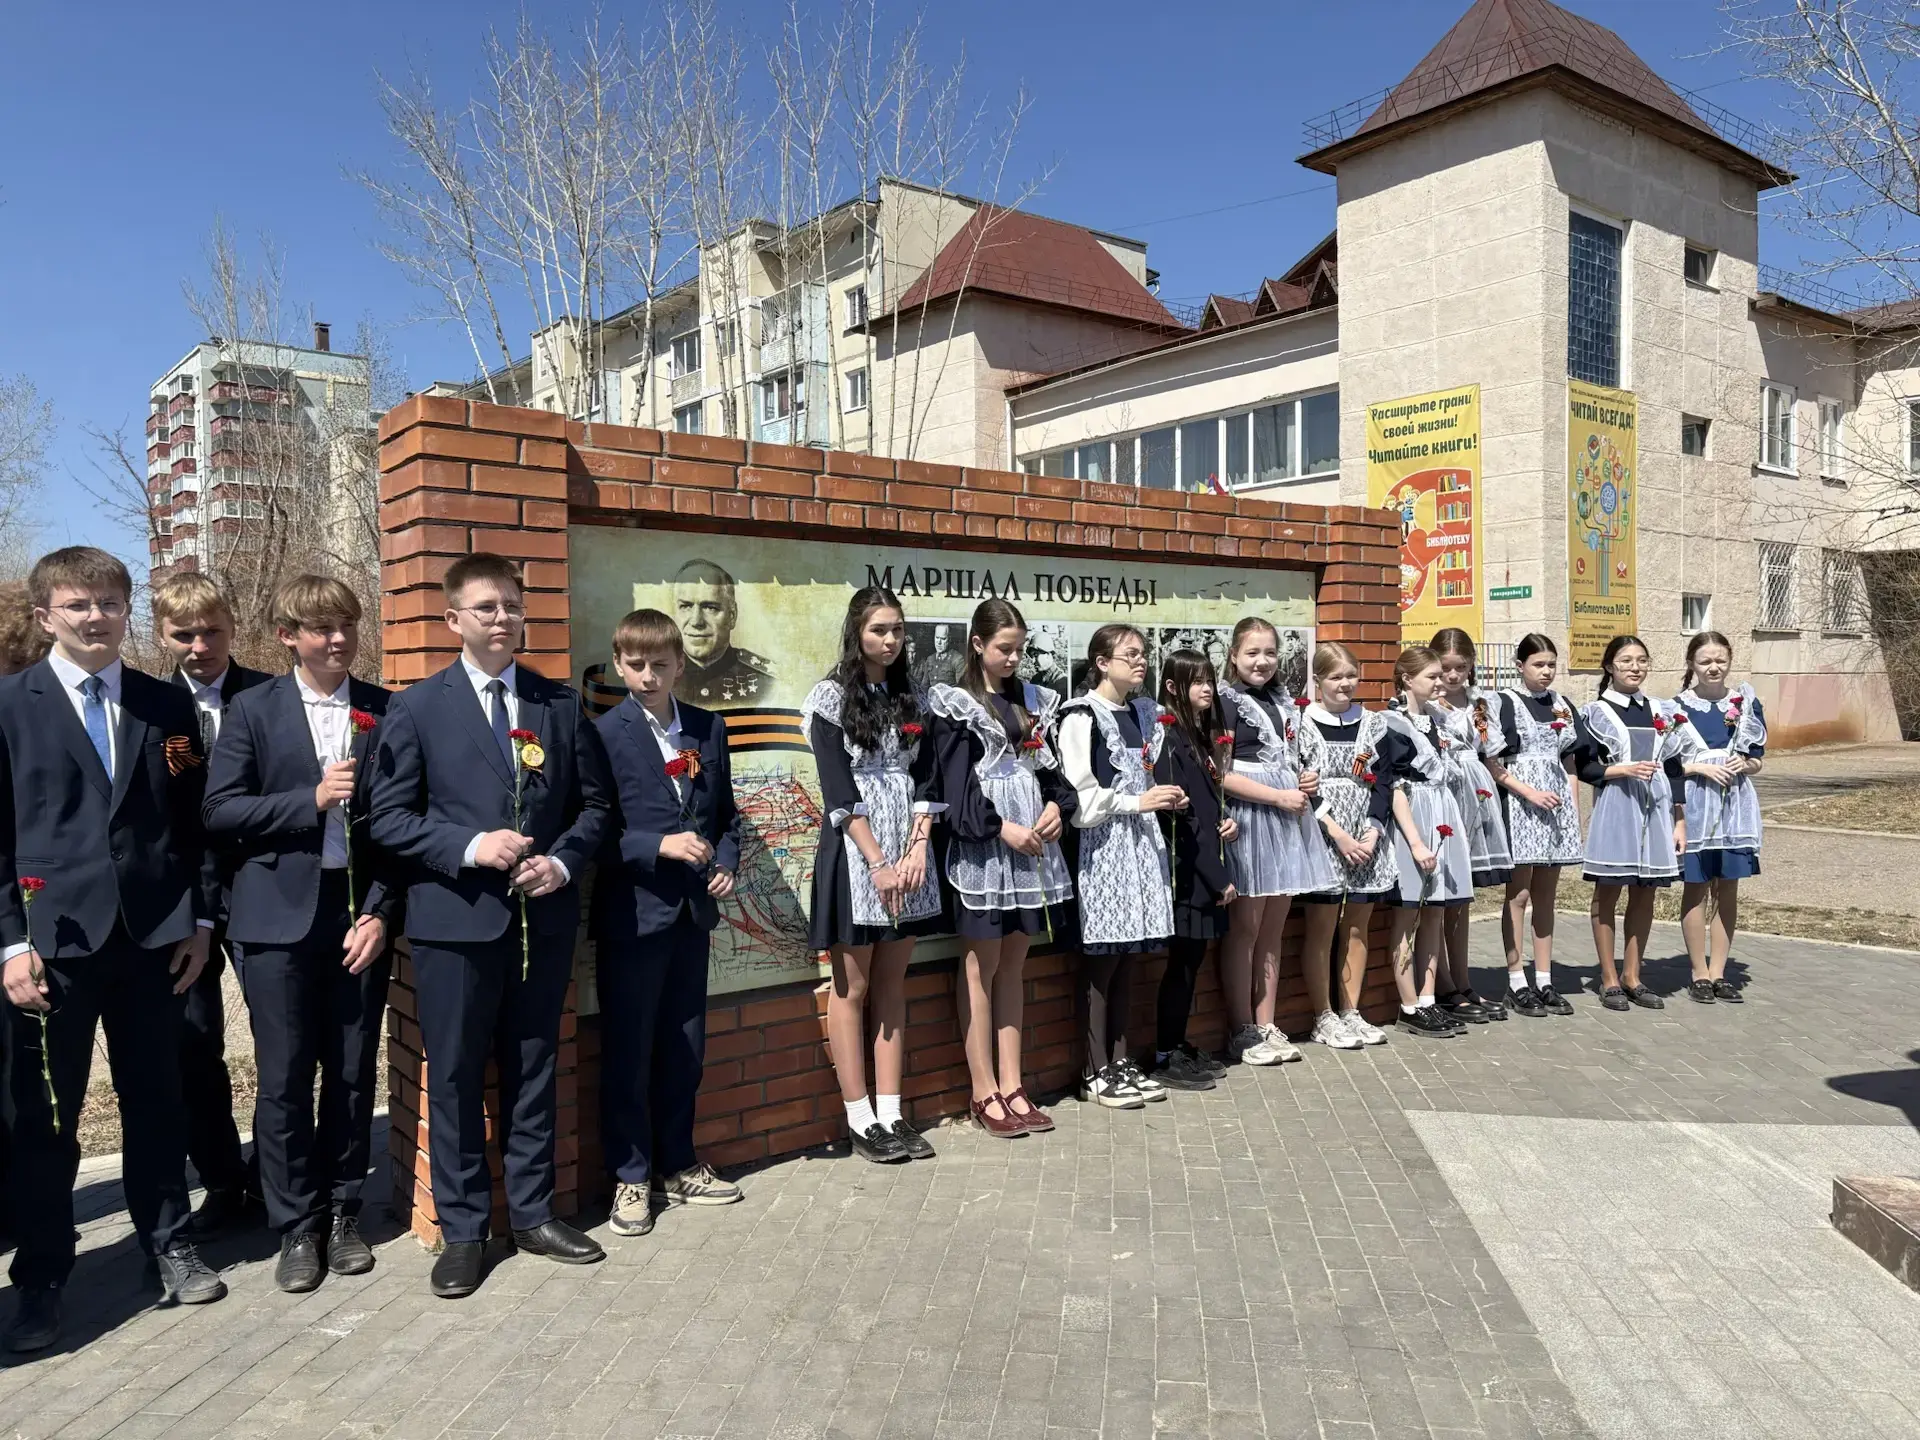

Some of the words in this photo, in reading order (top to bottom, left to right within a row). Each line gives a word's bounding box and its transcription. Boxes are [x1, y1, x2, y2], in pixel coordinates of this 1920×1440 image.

[1371, 400, 1437, 421] Расширьте
[1438, 394, 1472, 414] грани
[1570, 400, 1598, 423] ЧИТАЙ
[1599, 407, 1634, 431] ВСЕГДА!
[1383, 420, 1415, 439] своей
[1418, 414, 1458, 434] жизни!
[1368, 443, 1429, 464] Читайте
[1431, 433, 1478, 455] книги!
[1426, 533, 1471, 548] БИБЛИОТЕКУ
[865, 564, 1022, 601] МАРШАЛ
[1034, 573, 1158, 613] ПОБЕДЫ
[1574, 601, 1615, 615] Библиотека
[1625, 605, 1631, 616] 5
